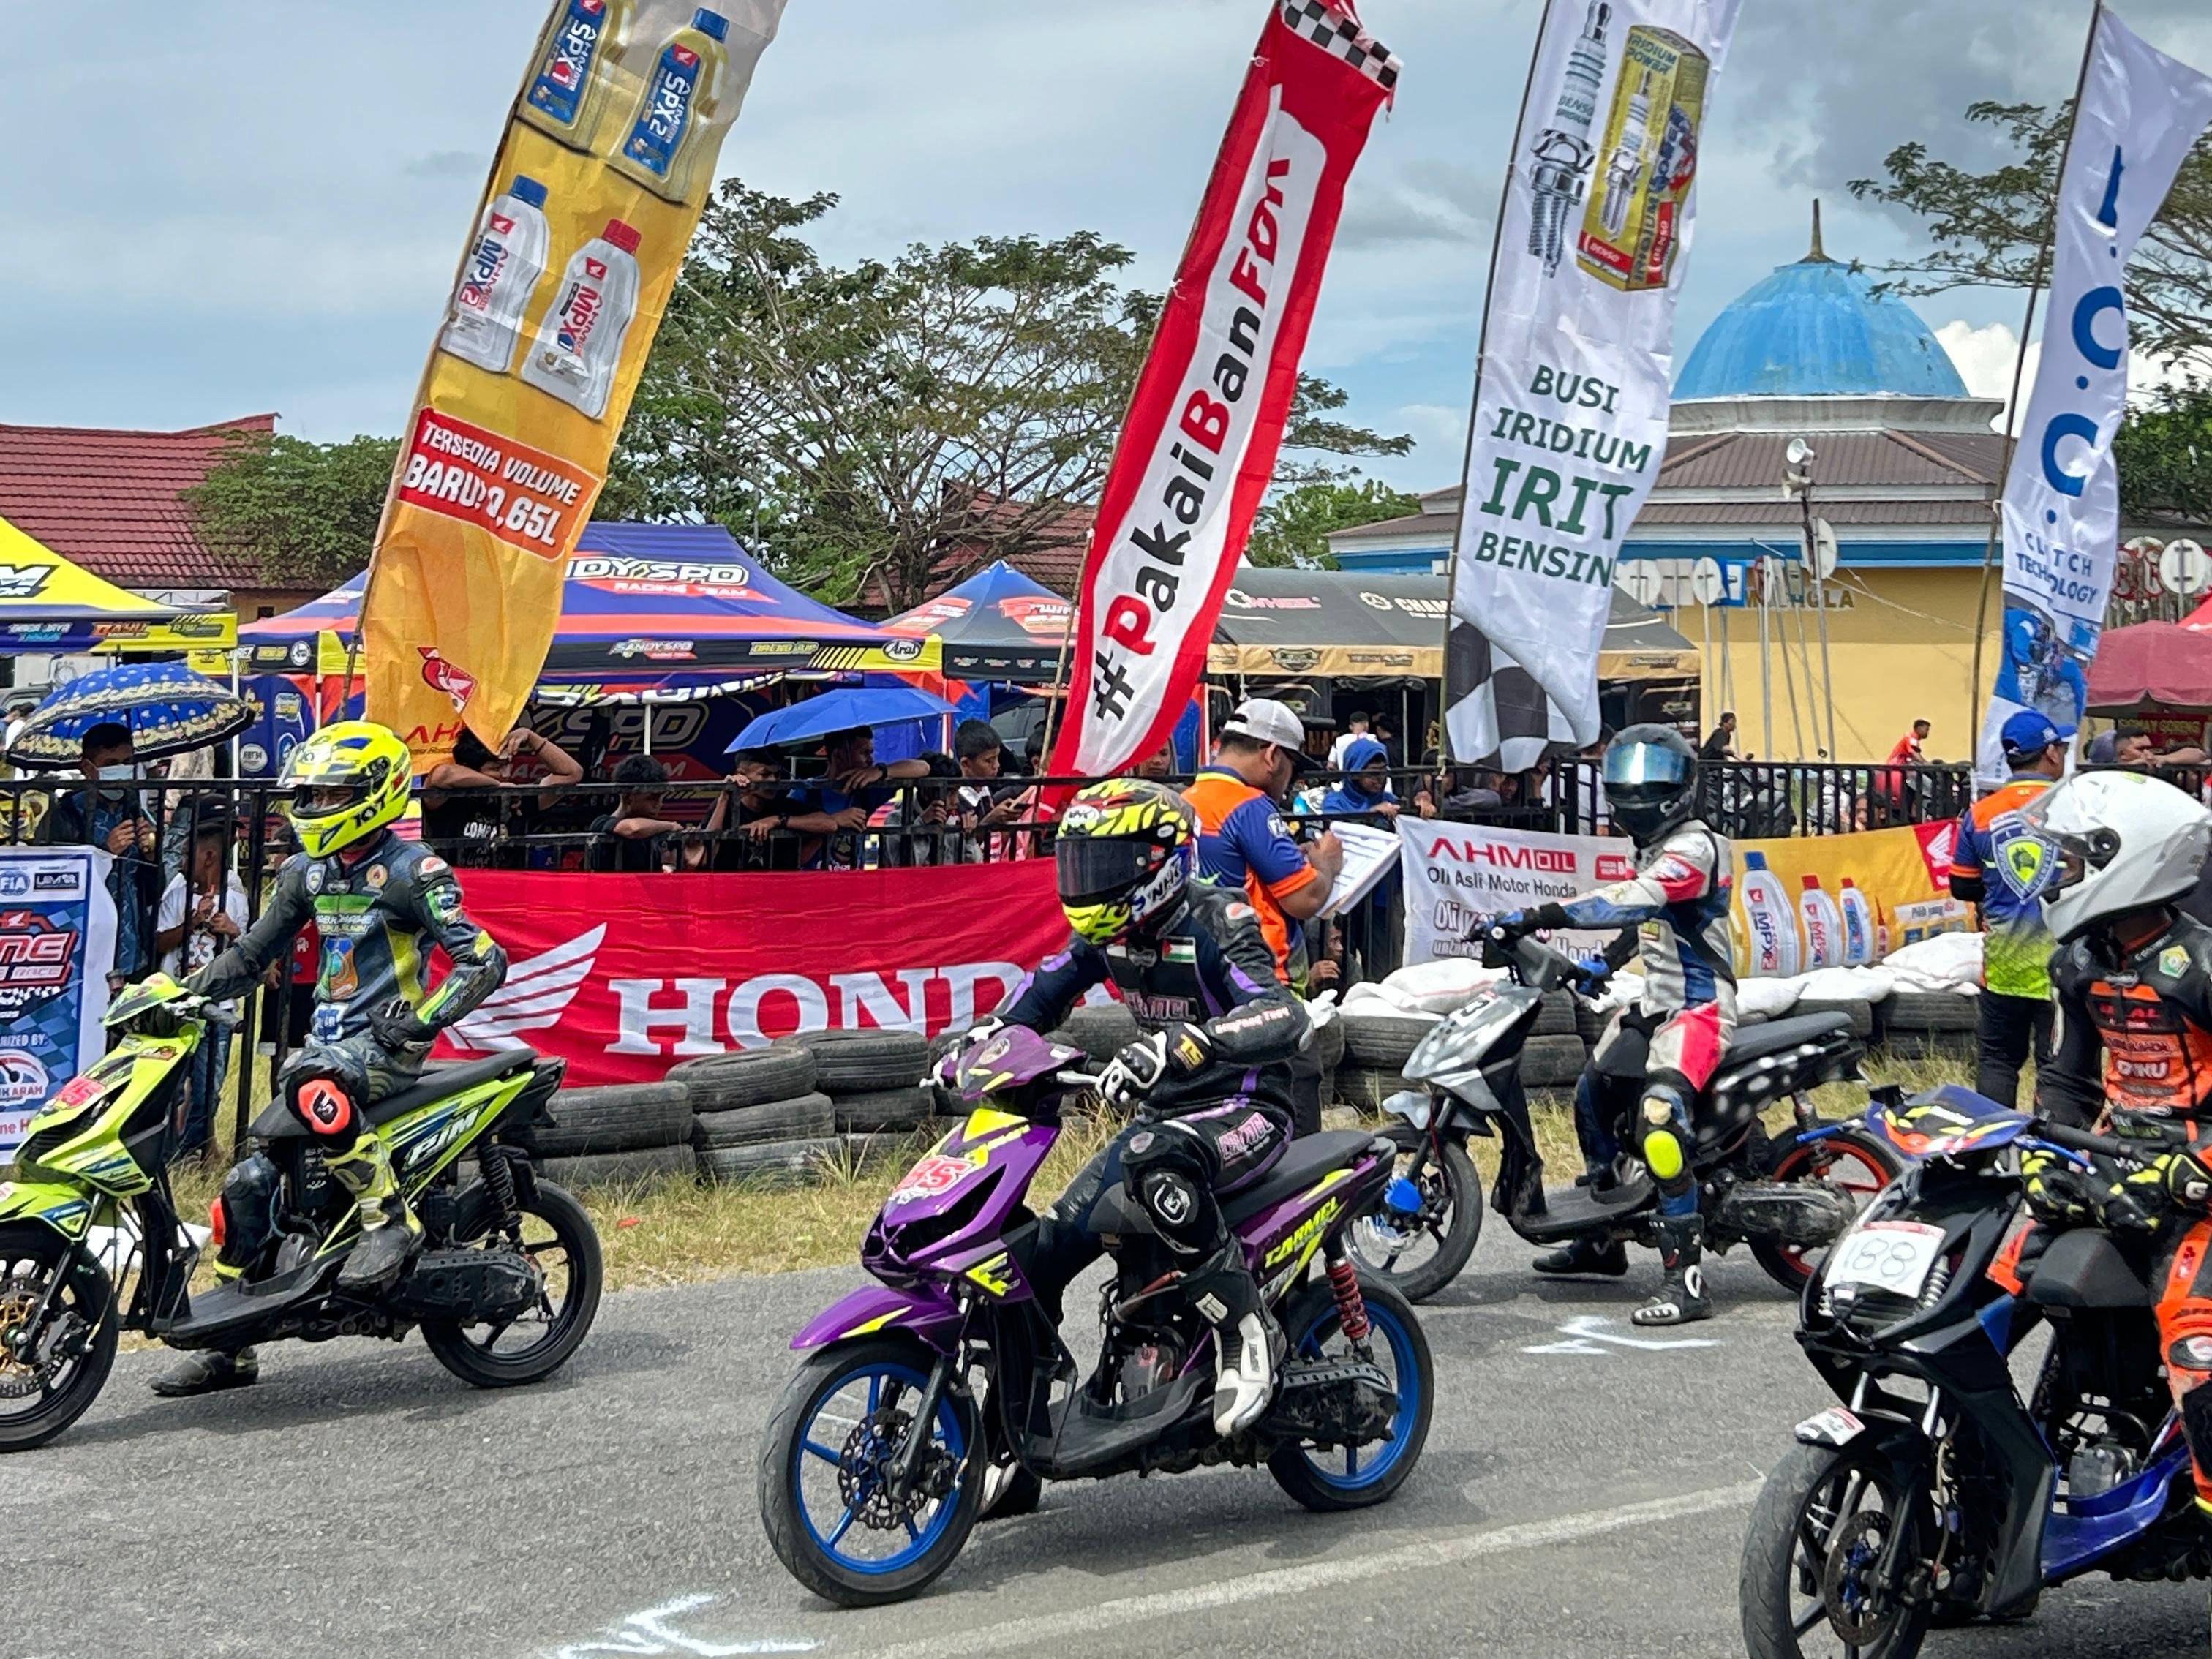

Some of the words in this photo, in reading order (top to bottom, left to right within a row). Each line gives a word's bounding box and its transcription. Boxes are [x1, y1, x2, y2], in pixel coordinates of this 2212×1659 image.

[459, 238, 503, 306] MPX2
[1530, 364, 1619, 415] BUSI
[421, 421, 502, 473] TERSEDIA
[503, 457, 582, 506] VOLUME
[1491, 407, 1651, 473] IRIDIUM
[1481, 456, 1635, 541] IRIT
[1475, 531, 1615, 587] BENSIN
[2025, 532, 2093, 577] CLTCH
[614, 582, 688, 595] RACING
[699, 585, 748, 598] TEAM
[890, 641, 917, 655] Arai
[1427, 866, 1451, 884] Oli
[1456, 873, 1483, 889] Asli
[1489, 875, 1530, 894] Motor
[1536, 879, 1578, 898] Honda
[1433, 899, 1460, 933] Oli
[1557, 937, 1604, 961] Hond
[604, 960, 1075, 1056] HOND
